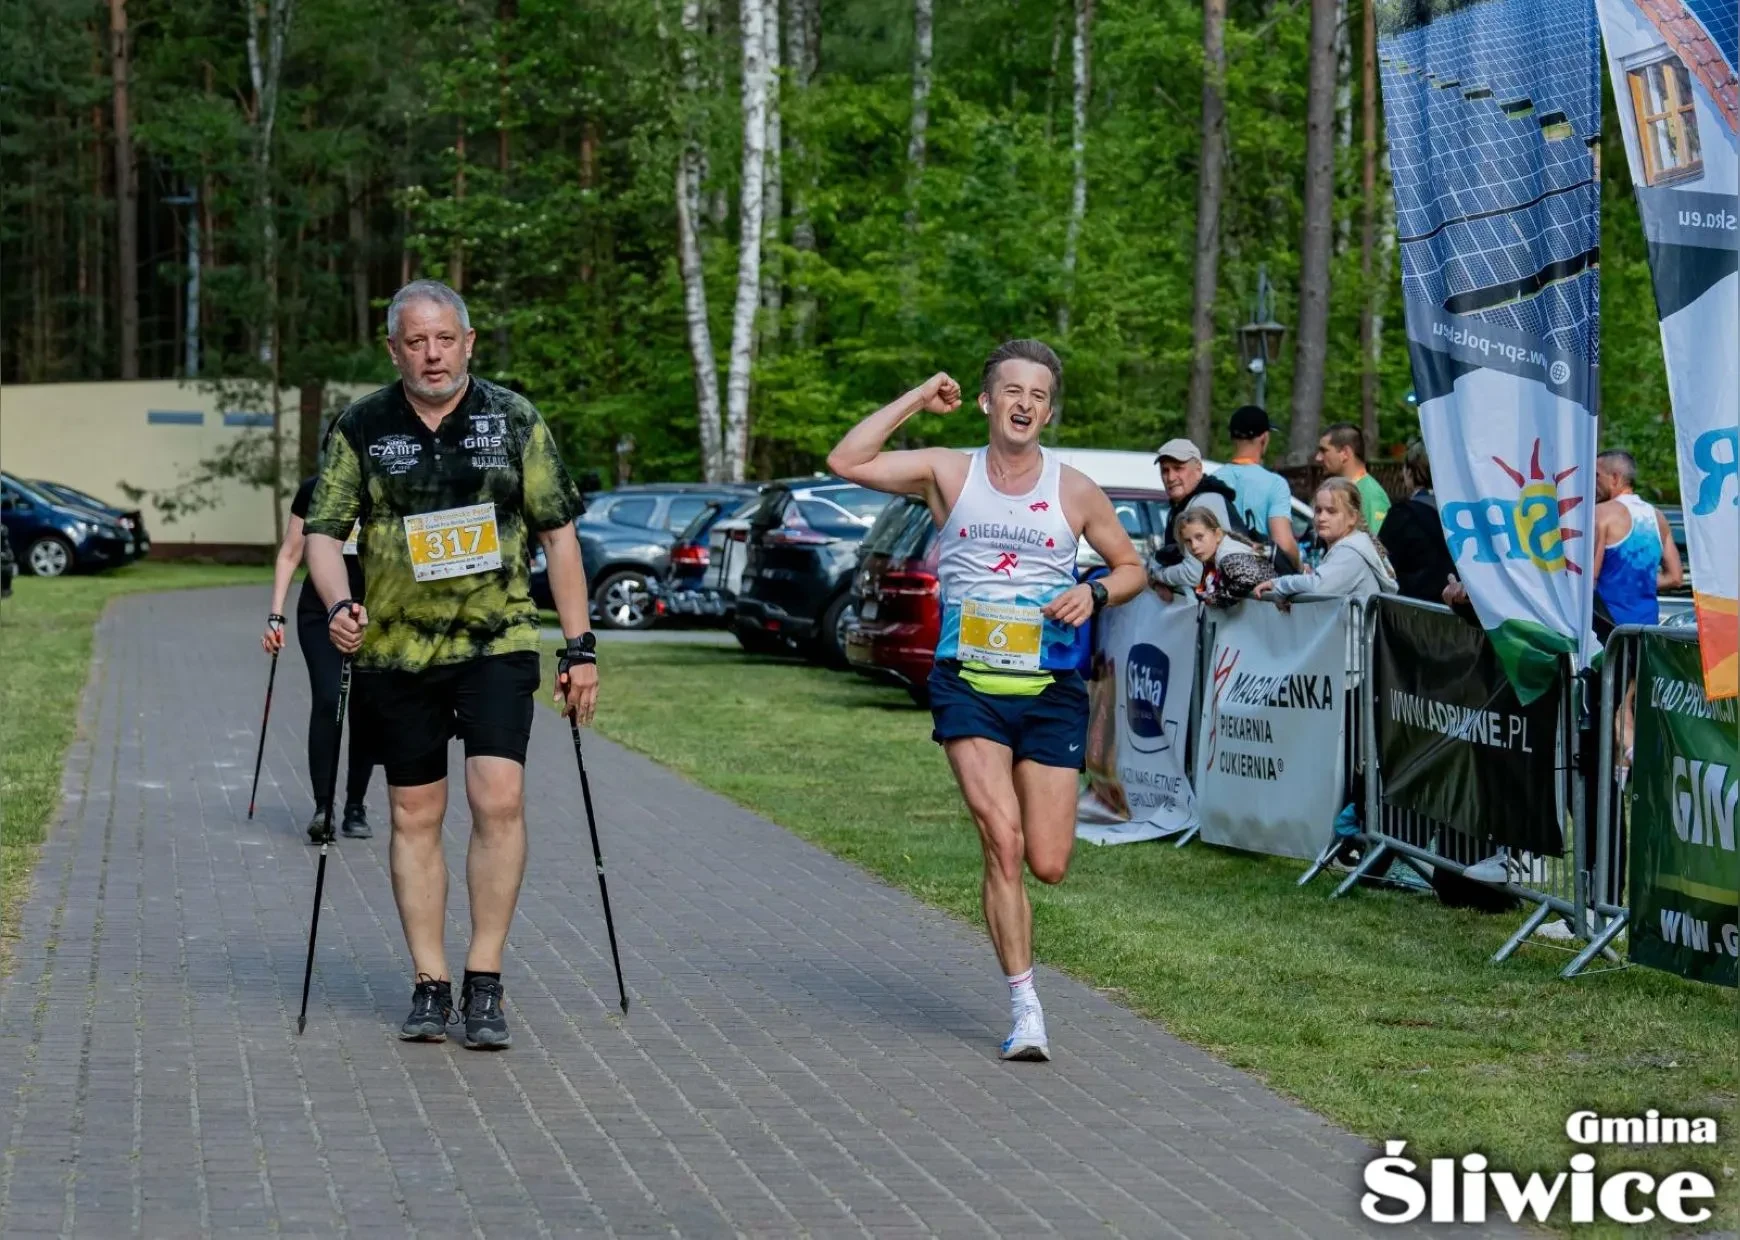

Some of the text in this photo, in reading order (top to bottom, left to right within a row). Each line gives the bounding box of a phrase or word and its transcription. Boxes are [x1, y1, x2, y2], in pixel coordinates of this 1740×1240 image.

[368, 444, 422, 456] CAMP
[464, 436, 502, 449] GMS
[425, 525, 483, 559] 317
[988, 621, 1009, 649] 6
[1127, 660, 1162, 706] Skiba
[1226, 671, 1333, 710] MAGDALENKA
[1220, 714, 1274, 743] PIEKARNIA
